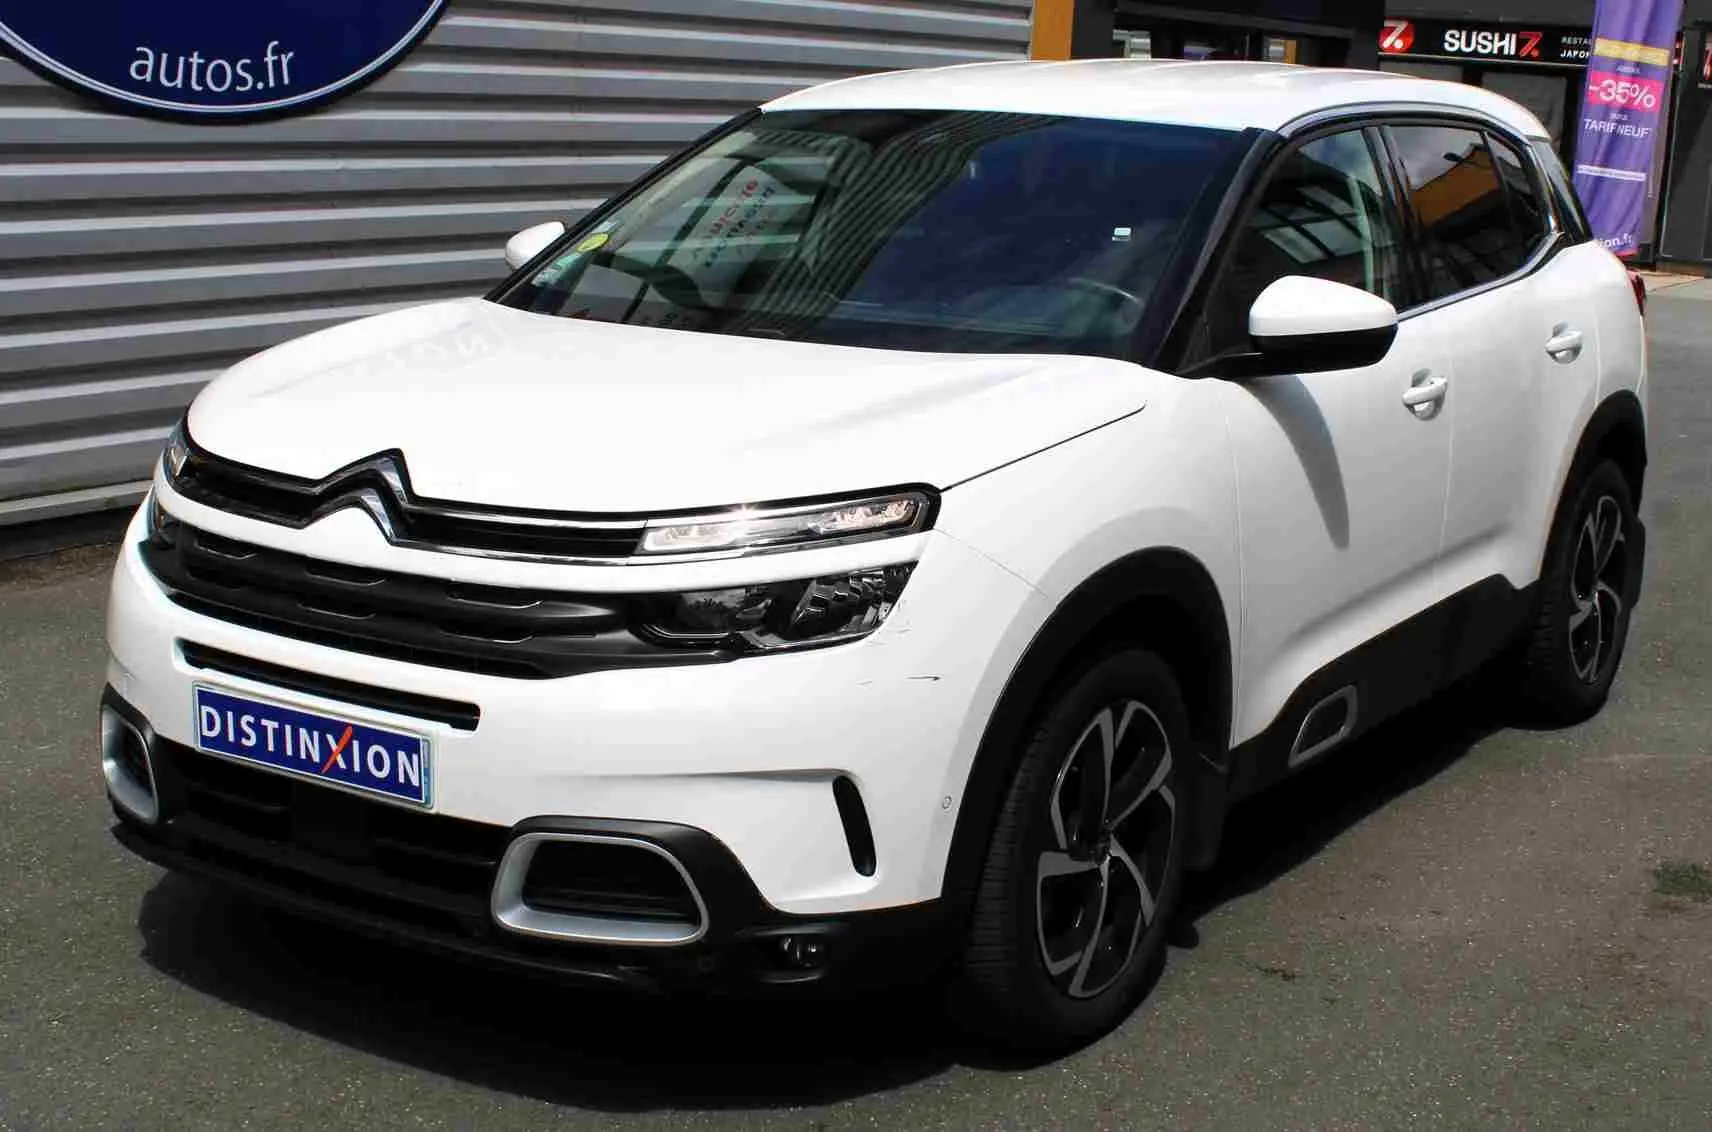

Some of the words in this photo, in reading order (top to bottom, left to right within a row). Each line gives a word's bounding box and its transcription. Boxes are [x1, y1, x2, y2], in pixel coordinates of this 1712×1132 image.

[129, 41, 294, 92] autos.fr
[1588, 79, 1656, 109] -35%
[1584, 118, 1617, 134] TARIF
[1616, 122, 1652, 138] NEUF
[200, 705, 420, 787] DISTINXION
